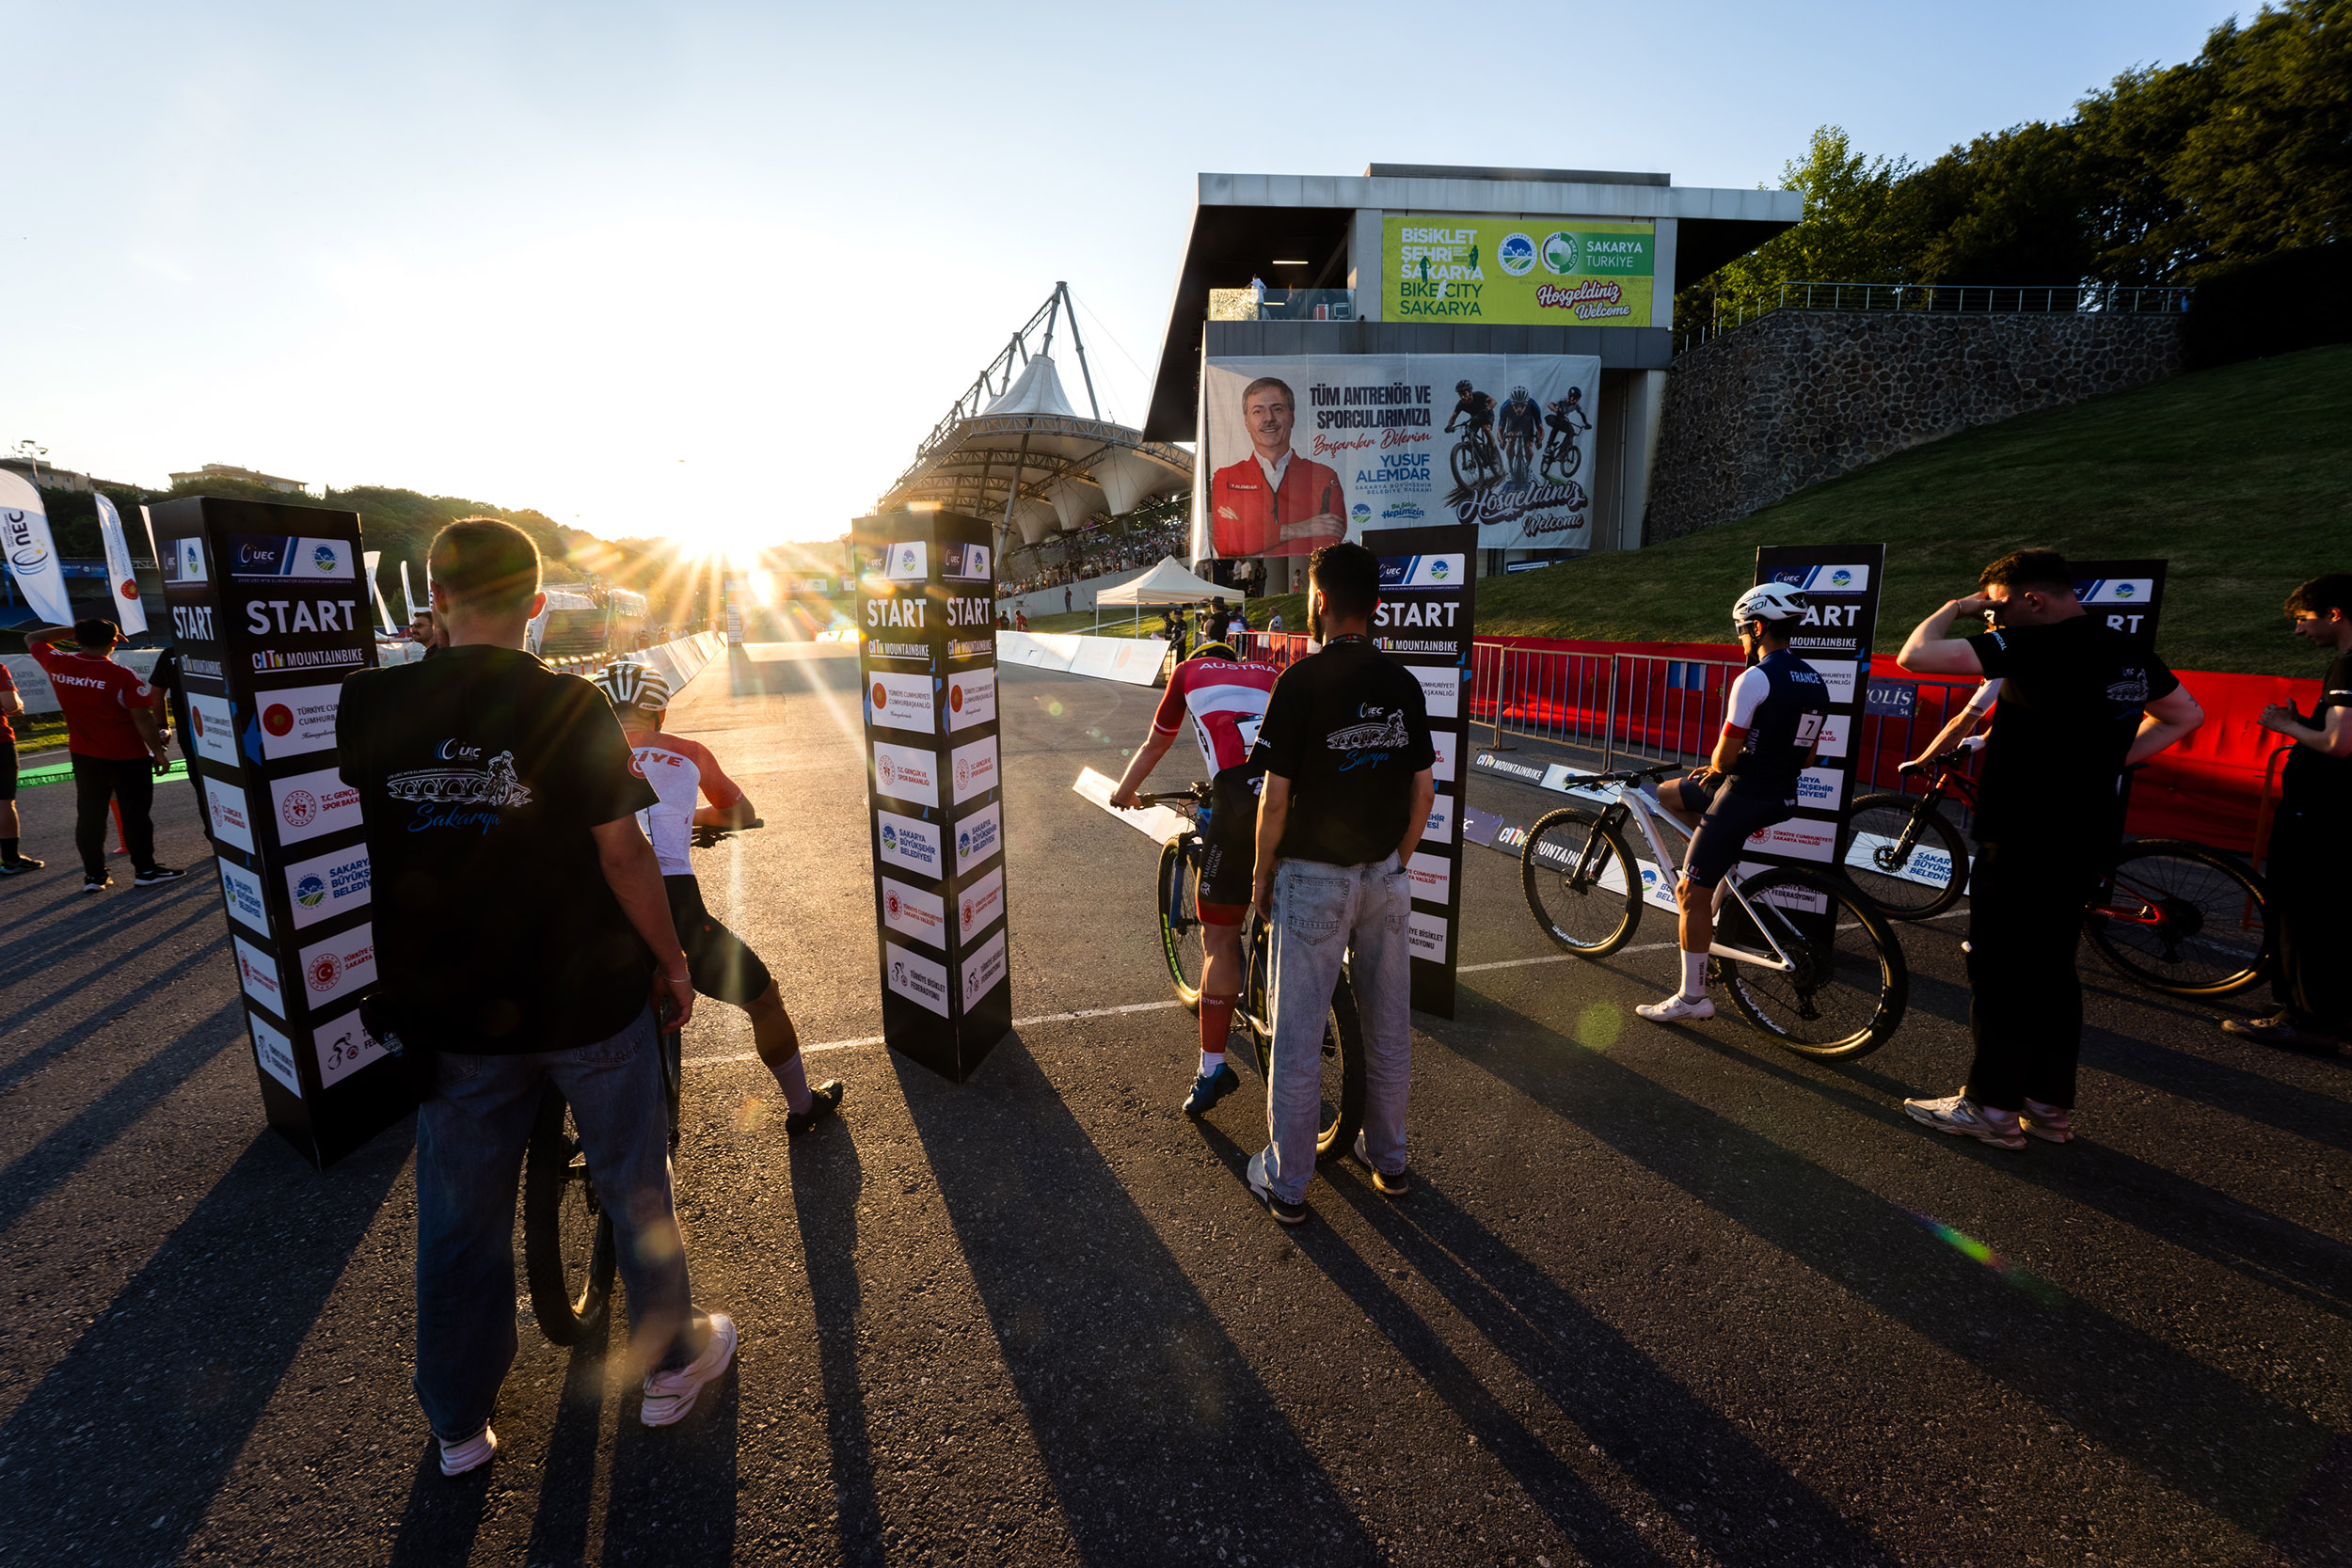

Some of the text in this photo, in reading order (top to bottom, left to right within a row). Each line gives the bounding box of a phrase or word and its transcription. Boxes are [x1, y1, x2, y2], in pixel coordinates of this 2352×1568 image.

[1549, 233, 1561, 242] UCI
[1586, 241, 1643, 254] SAKARYA
[1400, 264, 1485, 281] SAKARYA
[1400, 281, 1484, 298] BIKE CITY
[1537, 281, 1621, 307] Hoşgeldiniz
[1400, 299, 1483, 317] SAKARYA
[1574, 302, 1630, 320] Welcome
[1310, 382, 1432, 406] TÜM ANTRENÖR VE
[1317, 408, 1432, 430] SPORCULARIMIZA
[1313, 428, 1433, 459] Başarılar Dilerim
[1379, 453, 1431, 467] YUSUF
[1356, 467, 1431, 483] ALEMDAR
[8, 511, 32, 546] UEC
[1522, 514, 1583, 538] Welcome
[252, 549, 276, 562] UEC
[951, 555, 960, 563] UEC
[246, 600, 357, 635] START
[866, 598, 927, 628] START
[946, 596, 991, 627] START
[1374, 602, 1460, 627] START
[1799, 606, 1862, 626] ART
[172, 606, 215, 641] START
[884, 642, 930, 657] MOUNTAINBIKE
[961, 639, 993, 654] MOUNTAINBIKE
[1395, 640, 1458, 652] MOUNTAINBIKE
[1789, 637, 1857, 647] MOUNTAINBIKE
[287, 648, 364, 668] MOUNTAINBIKE
[1199, 662, 1279, 674] AUSTRIA
[52, 672, 106, 690] TÜRKİYE
[1789, 670, 1821, 685] FRANCE
[297, 705, 326, 716] TÜRKİYE
[1899, 707, 1909, 716] 54
[298, 715, 336, 726] CUMHURB
[1805, 720, 1816, 736] 7
[1257, 736, 1271, 749] CIAL
[1476, 752, 1544, 781] CITY MOUNTAINBIKE
[1797, 781, 1834, 793] ÜKŞEHİR
[321, 794, 334, 802] T.C.
[322, 797, 360, 812] SPOR BAKA
[407, 802, 501, 836] Sakarya
[972, 819, 992, 835] SAKARYA
[898, 828, 927, 843] SAKARYA
[972, 824, 997, 844] BÜYÜKŞEHİR
[1499, 824, 1527, 847] CITY
[1795, 833, 1834, 843] CUMHURİYETİ
[899, 837, 936, 856] BÜYÜKŞEHİR
[973, 833, 995, 853] BELEDİYESİ
[900, 847, 933, 863] BELEDİYESİ
[1917, 851, 1951, 866] SAKAR
[331, 868, 371, 889] BÜYÜKŞ
[1413, 869, 1448, 881] CUMHURİYETİ
[333, 879, 372, 899] BELEDİY
[1772, 889, 1815, 903] FEDERASYONU
[1419, 927, 1443, 942] BİSİKLET
[343, 950, 369, 963] TÜRKİYE
[344, 954, 373, 971] SAKARYA
[910, 969, 946, 993] TÜRKİYE BİSİKLET
[910, 980, 940, 1002] FEDERASYONU
